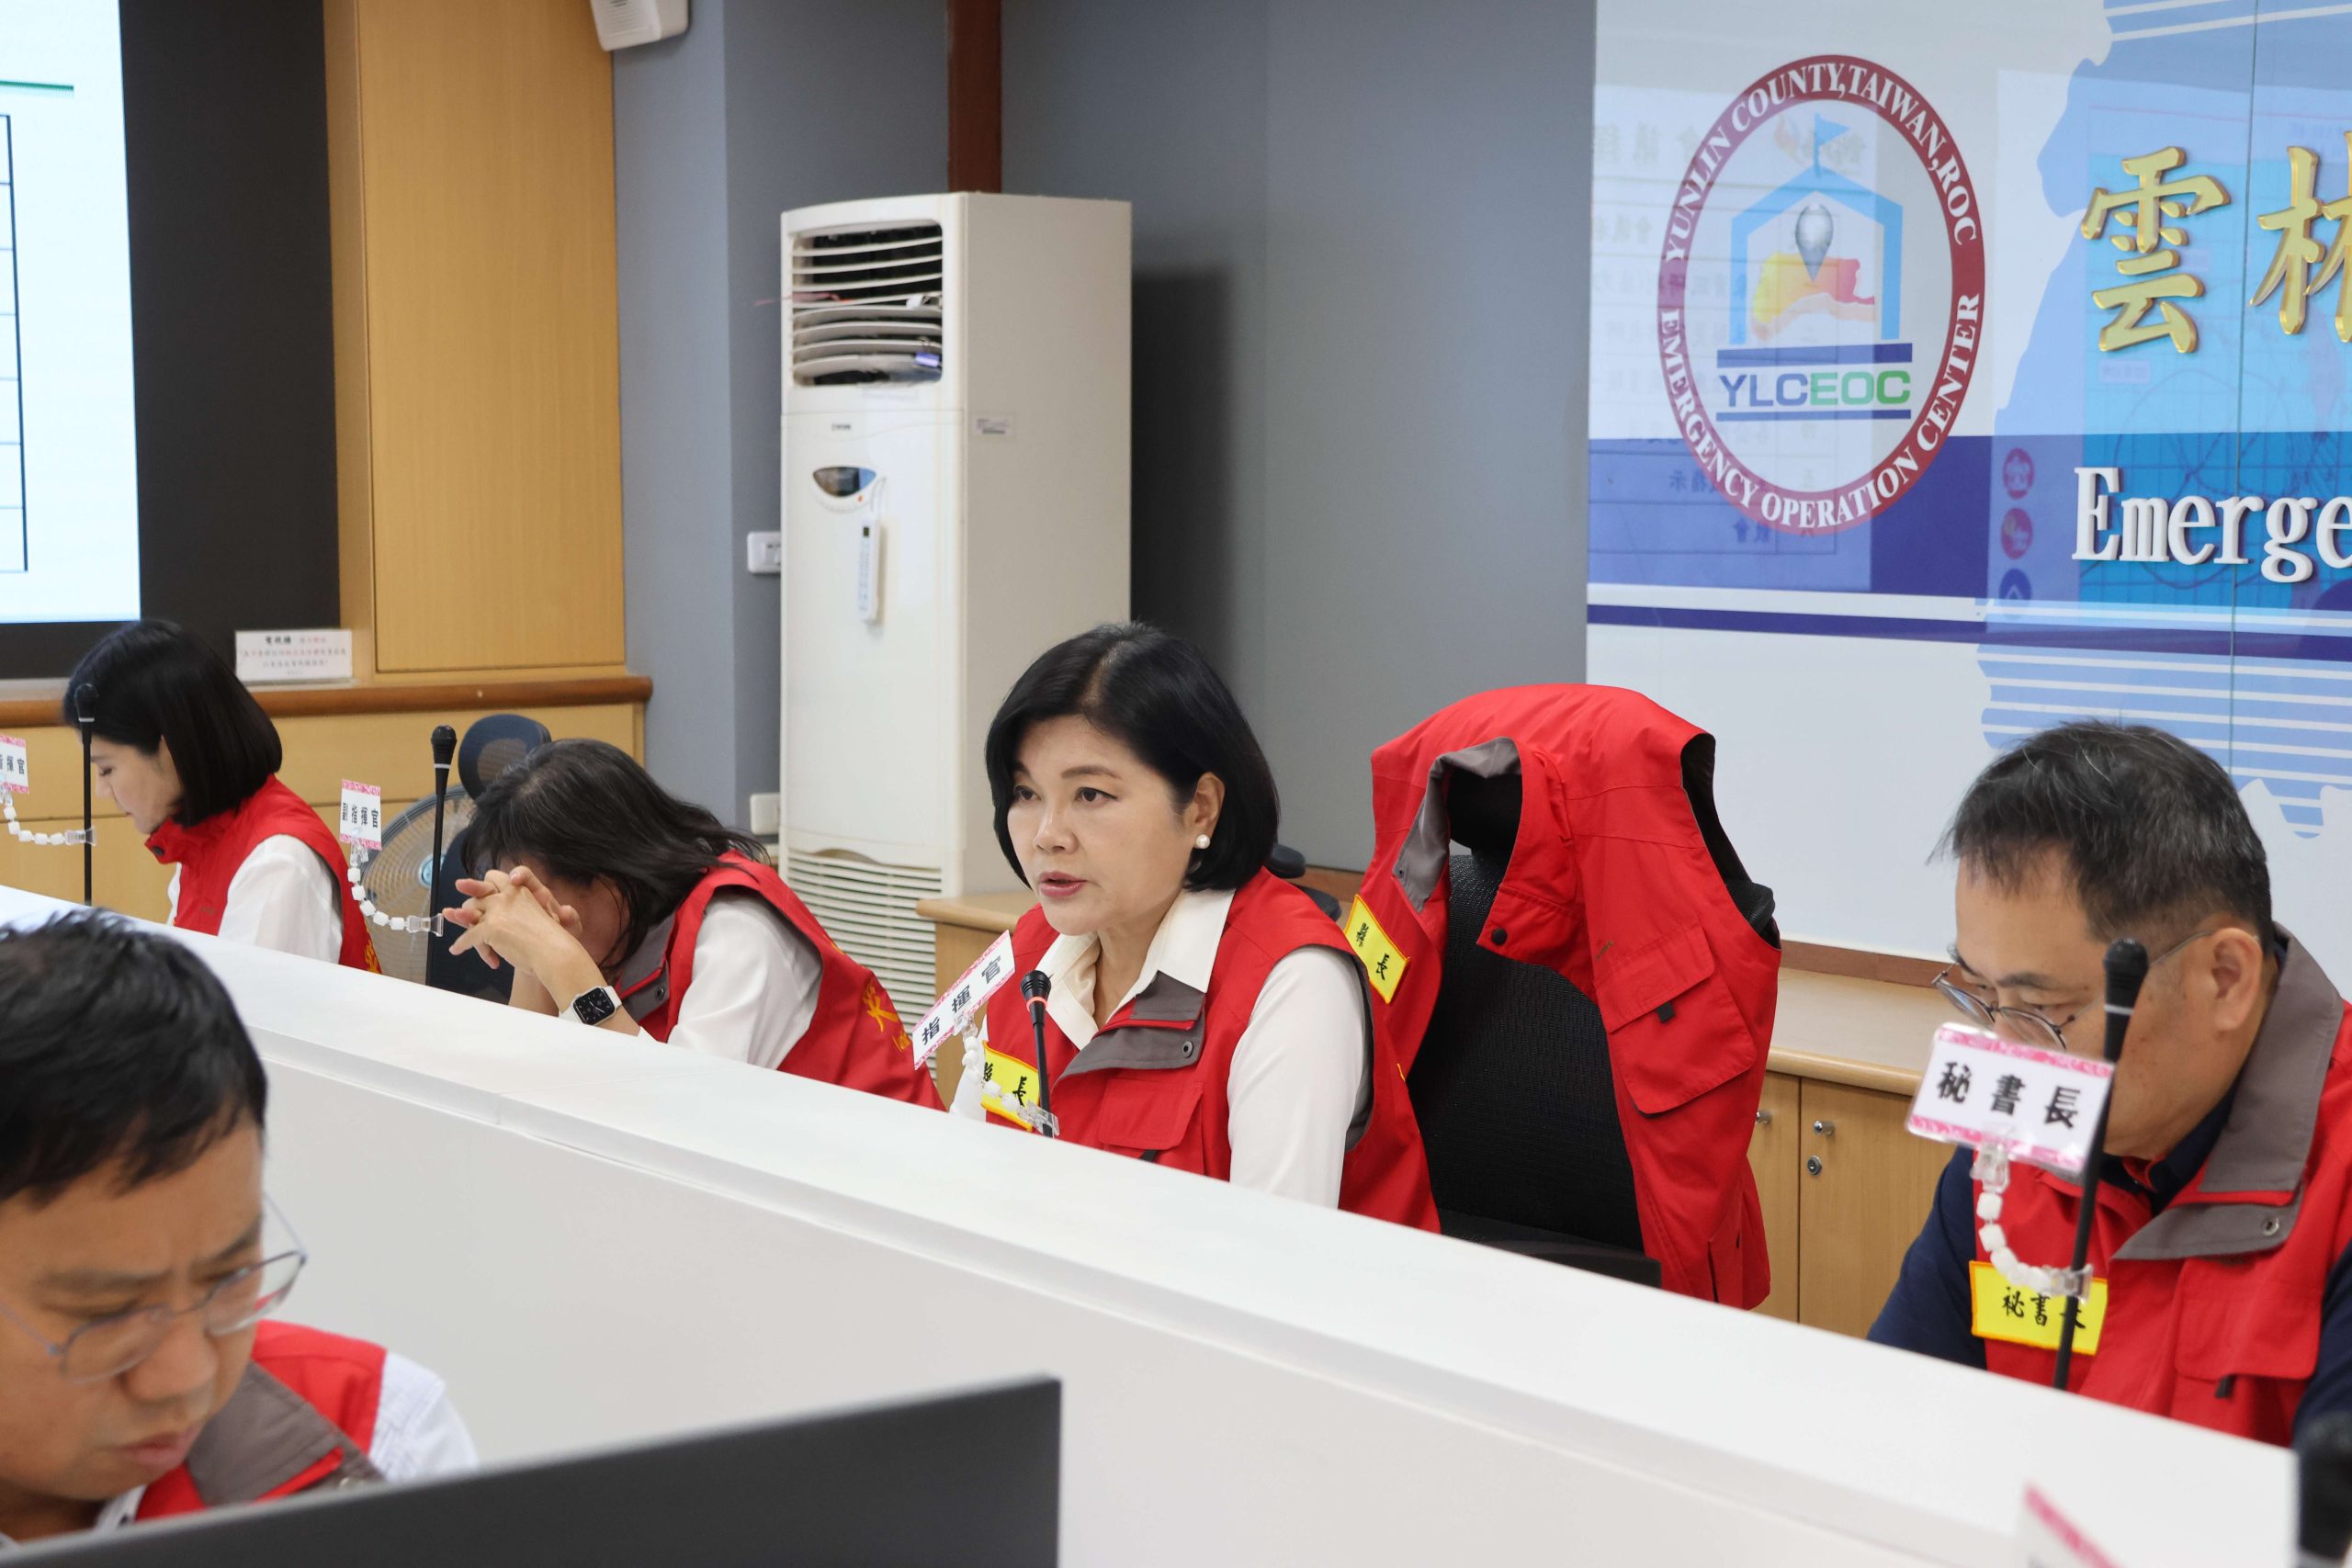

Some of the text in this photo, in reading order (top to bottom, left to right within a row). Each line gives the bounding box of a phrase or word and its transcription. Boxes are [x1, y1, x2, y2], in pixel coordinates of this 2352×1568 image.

[1665, 128, 1732, 264] YUNLIN
[1660, 293, 1981, 529] EMERGENCY OPERATION CENTER
[1719, 370, 1912, 408] YLCEOC
[2071, 466, 2352, 584] Emerge
[922, 955, 1001, 1046] 指揮官
[1936, 1061, 2083, 1129] 秘書長
